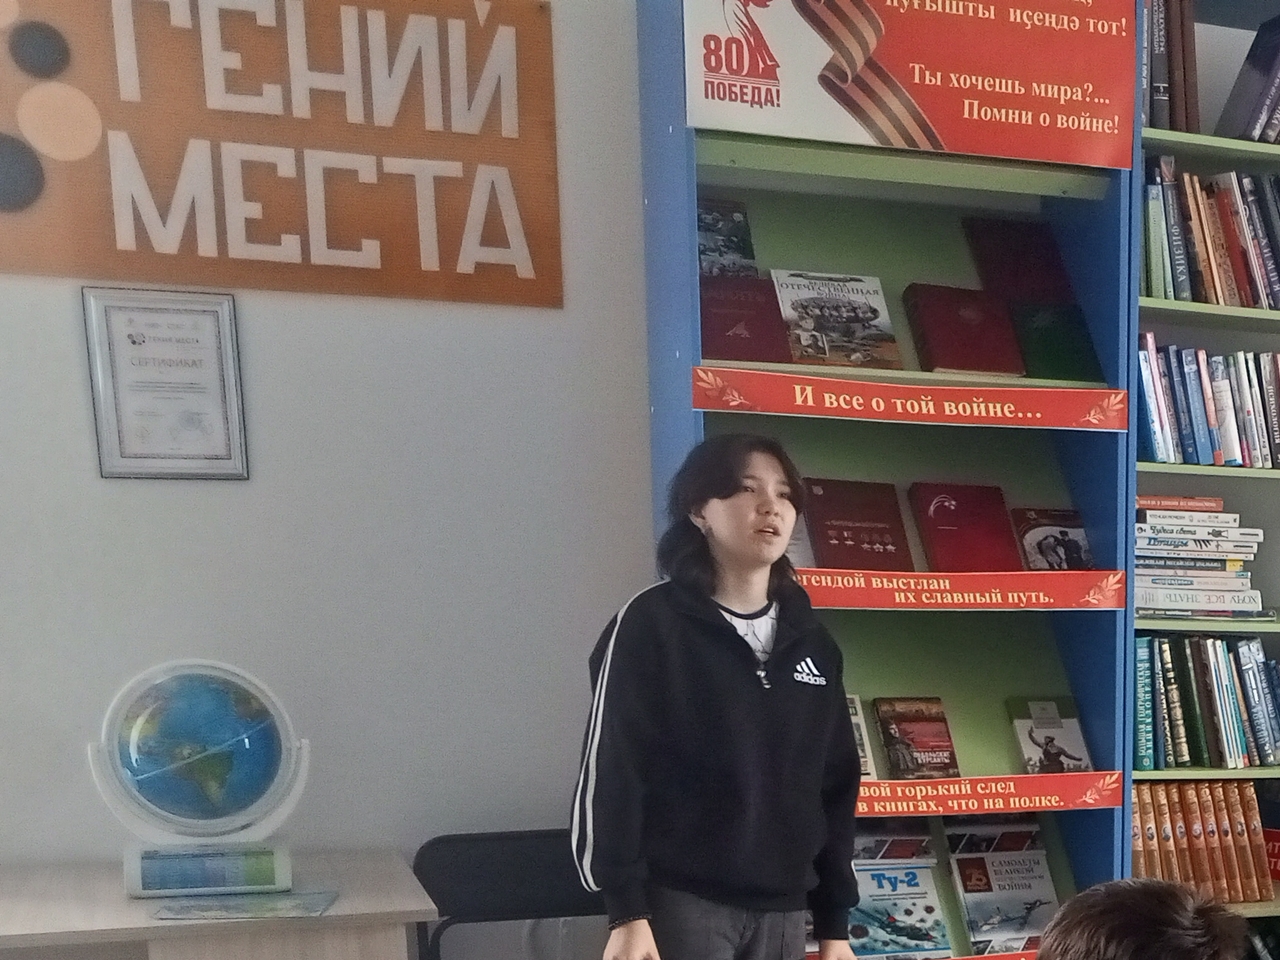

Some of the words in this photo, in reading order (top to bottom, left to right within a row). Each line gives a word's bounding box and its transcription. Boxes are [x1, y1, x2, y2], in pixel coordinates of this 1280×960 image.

[1086, 17, 1127, 37] тот!
[703, 34, 745, 76] 80
[111, 0, 520, 139] ГЕНИЙ
[909, 63, 942, 86] Ты
[949, 72, 1026, 95] хочешь
[1032, 81, 1110, 105] мира?...
[704, 80, 781, 109] ПОБЕДА!
[963, 99, 1033, 125] Помни
[1039, 112, 1050, 127] о
[1056, 111, 1120, 135] войне!
[107, 130, 536, 280] МЕСТА
[1171, 225, 1187, 283] ФИЗИКА
[793, 384, 816, 407] И
[823, 392, 865, 411] все
[872, 396, 885, 412] о
[891, 395, 937, 415] той
[944, 397, 1042, 419] войне...
[1150, 525, 1175, 536] Чудеса
[1175, 526, 1197, 536] света
[872, 575, 950, 590] выстлан
[895, 590, 916, 604] их
[921, 589, 1002, 604] славный
[1007, 590, 1055, 607] путь.
[1164, 592, 1202, 604] ЗНАТЬ
[1204, 593, 1226, 604] ВСЕ
[1229, 593, 1259, 605] ХОЧУ
[793, 671, 827, 686] adidas
[896, 781, 972, 799] горький
[976, 781, 1016, 794] след
[857, 801, 869, 813] в
[874, 800, 944, 814] книгах,
[948, 798, 978, 811] что
[983, 796, 1004, 809] на
[1009, 794, 1065, 808] полке.
[870, 871, 920, 892] Ту-2
